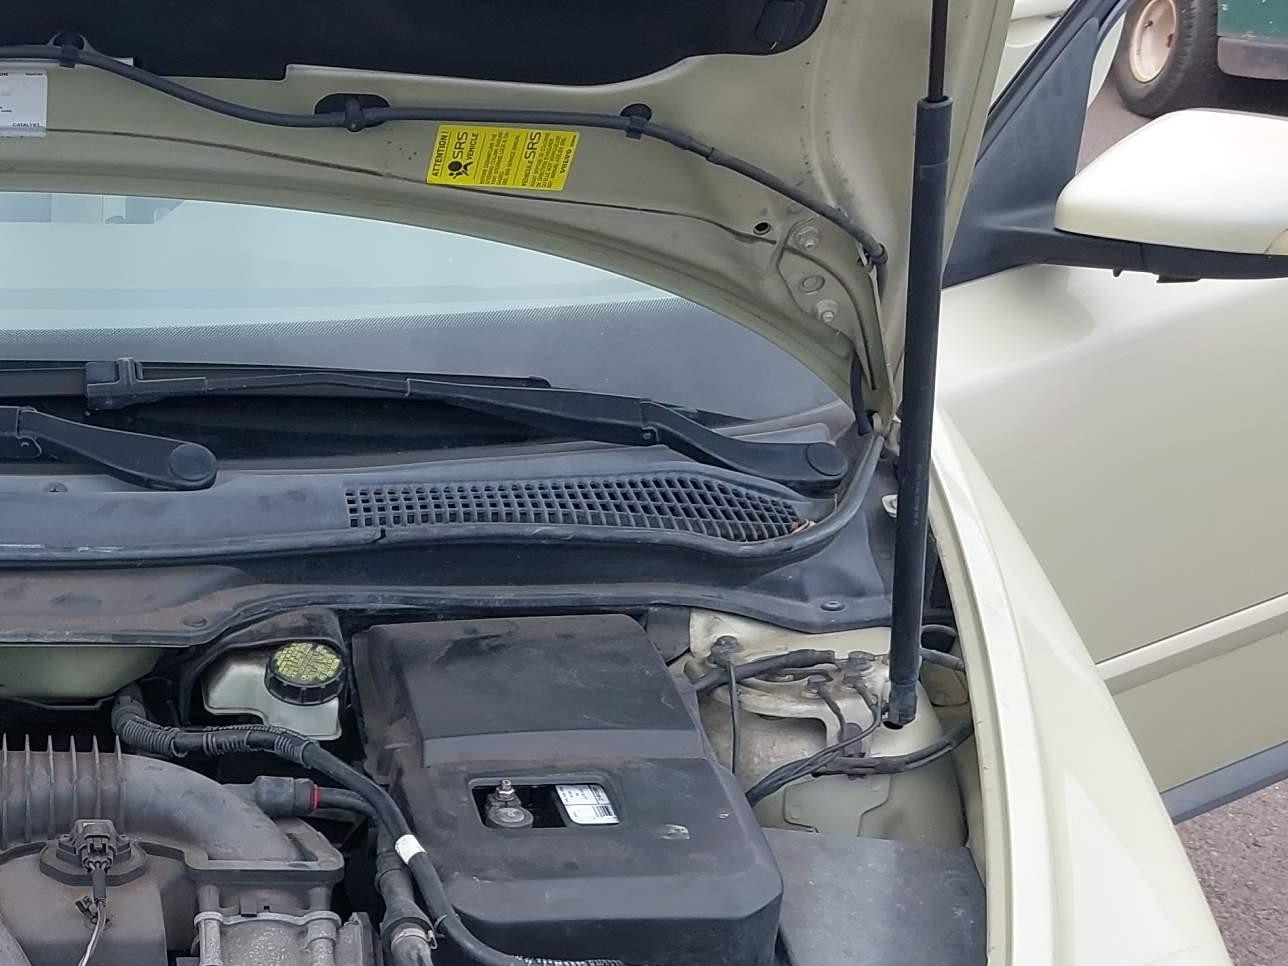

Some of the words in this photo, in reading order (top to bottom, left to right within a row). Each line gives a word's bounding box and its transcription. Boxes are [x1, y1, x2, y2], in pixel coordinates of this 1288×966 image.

[432, 137, 447, 176] ATTENTION
[453, 132, 468, 160] SRS
[466, 133, 478, 161] VEHICLE
[525, 132, 541, 160] SRS
[560, 150, 572, 174] VOLVO
